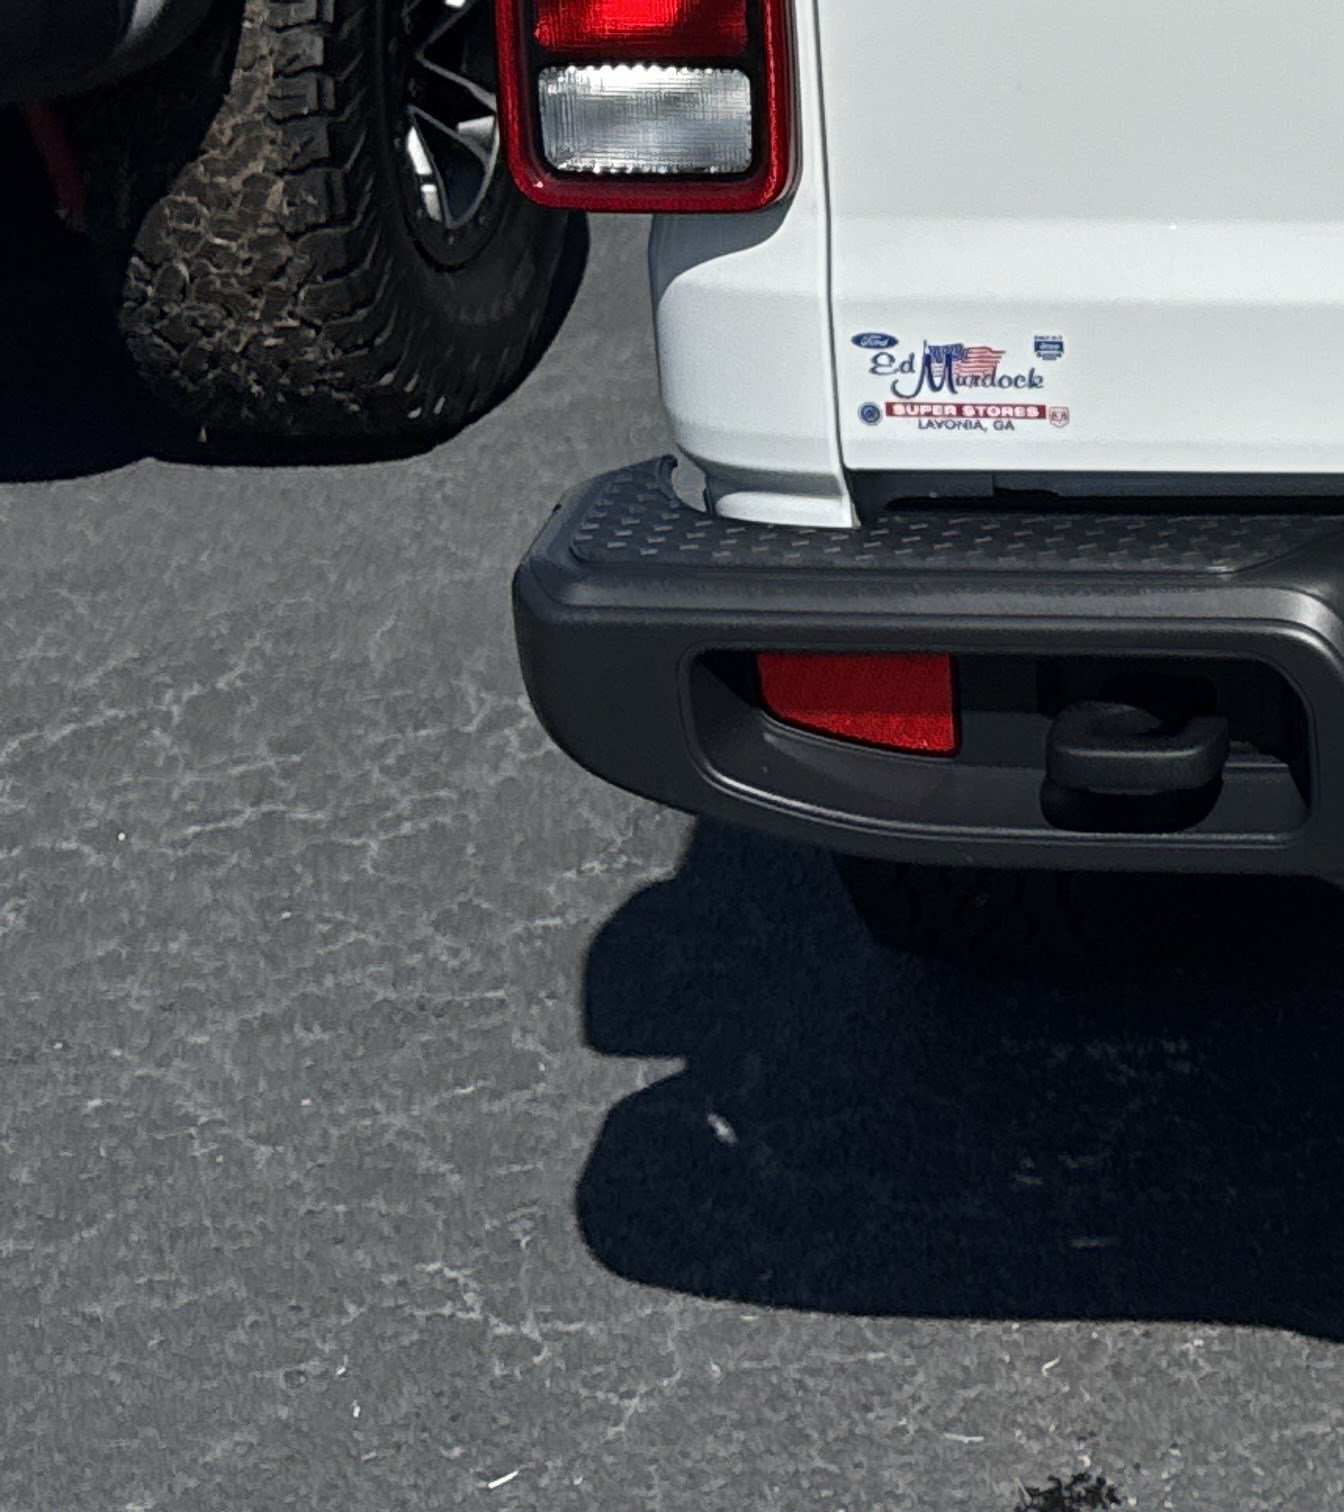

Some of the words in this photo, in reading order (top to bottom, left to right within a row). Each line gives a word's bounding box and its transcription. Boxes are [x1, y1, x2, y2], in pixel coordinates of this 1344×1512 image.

[869, 352, 916, 375] Ed
[891, 352, 1043, 399] Murdock
[892, 403, 958, 417] SUPER
[962, 404, 1039, 418] STORES
[918, 419, 987, 432] LAVONIA,
[993, 420, 1014, 431] GA
